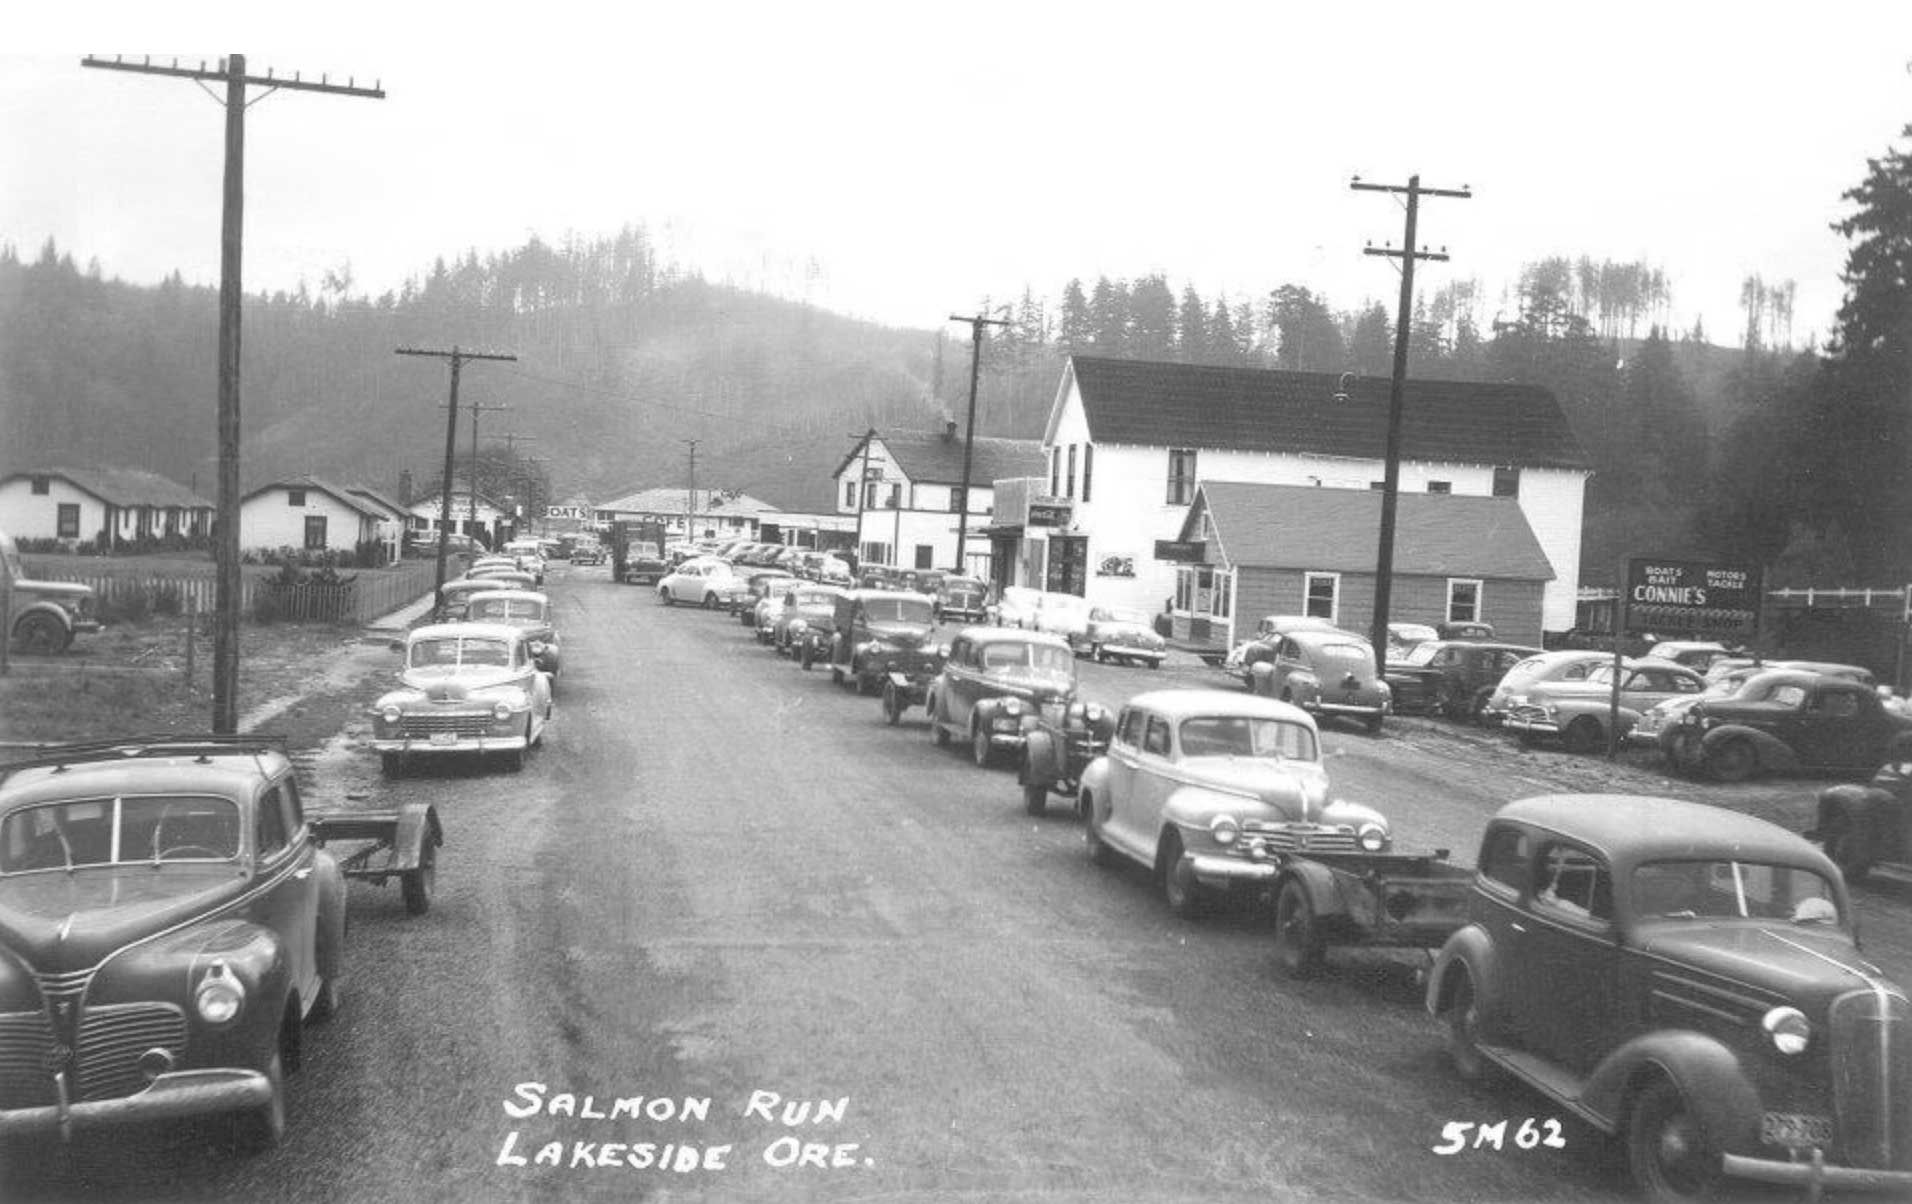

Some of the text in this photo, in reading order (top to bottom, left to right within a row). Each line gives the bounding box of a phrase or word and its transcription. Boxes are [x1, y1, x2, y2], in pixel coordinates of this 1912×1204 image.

[1645, 566, 1682, 576] BOATS
[1706, 570, 1747, 581] MOTORS
[1649, 575, 1677, 584] BAIT
[1707, 579, 1744, 589] TACKLE
[1634, 585, 1707, 605] CONNIE'S
